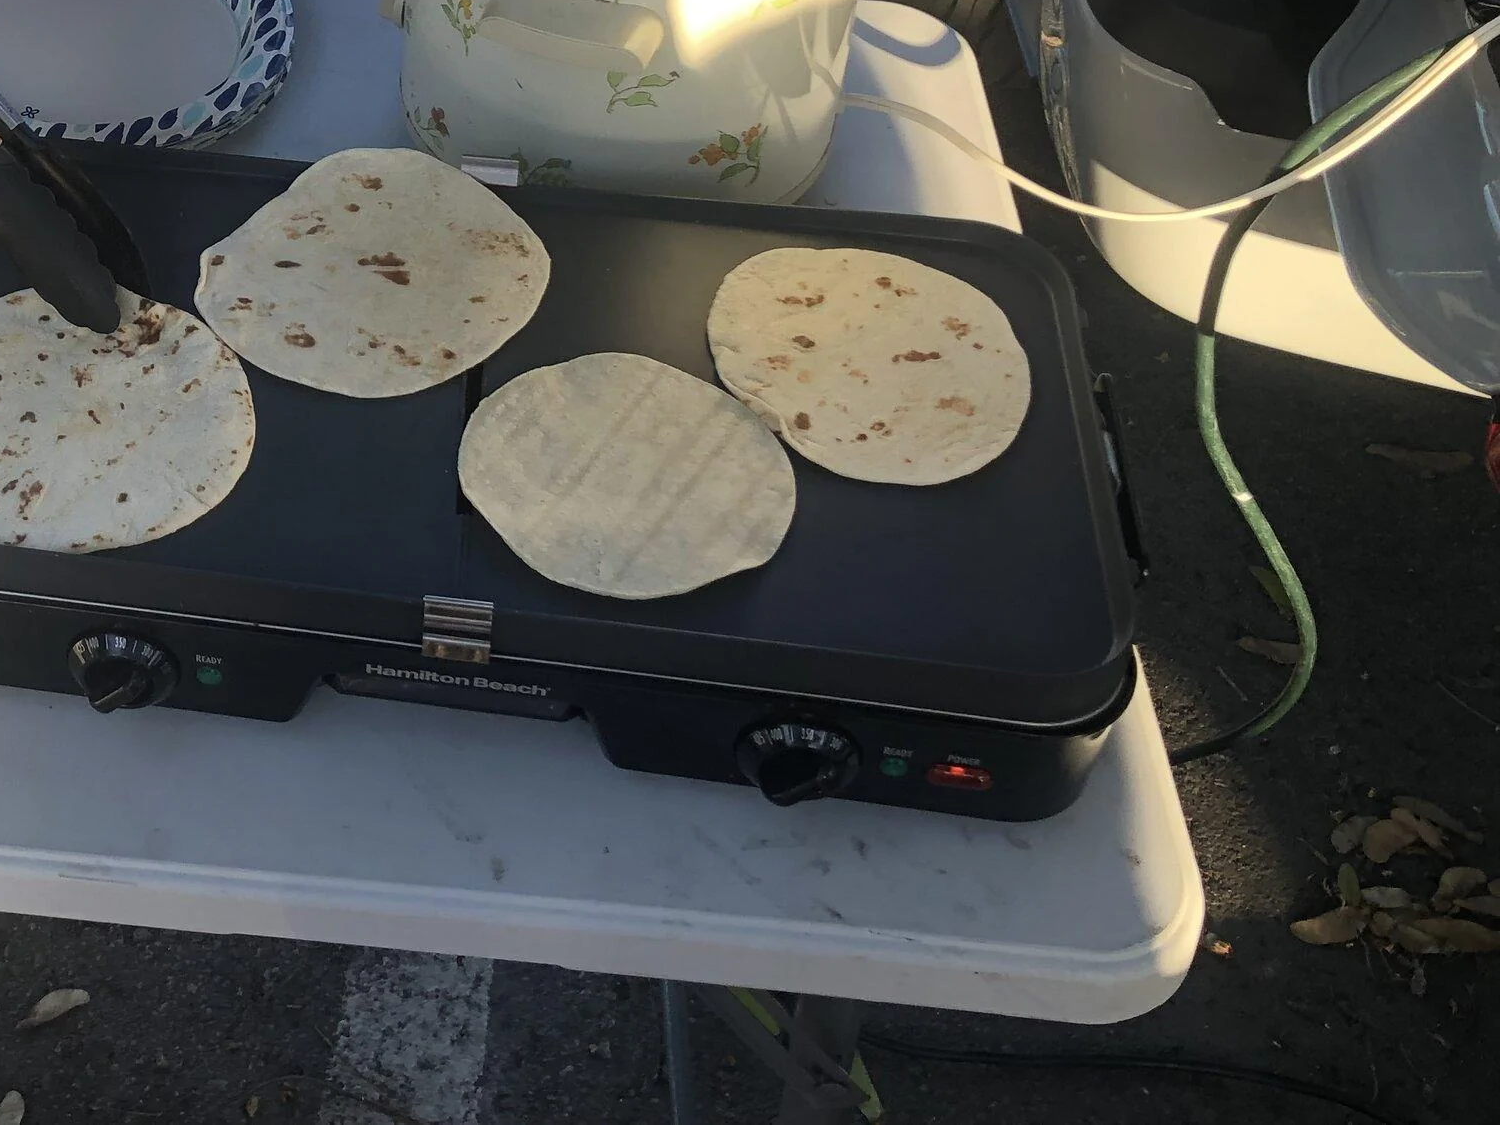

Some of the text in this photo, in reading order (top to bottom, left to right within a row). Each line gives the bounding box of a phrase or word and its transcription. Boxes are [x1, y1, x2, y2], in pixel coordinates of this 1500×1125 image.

[114, 636, 127, 650] 350
[195, 654, 222, 665] READY
[365, 663, 547, 697] Hamilton Beach
[946, 754, 981, 766] POWER
